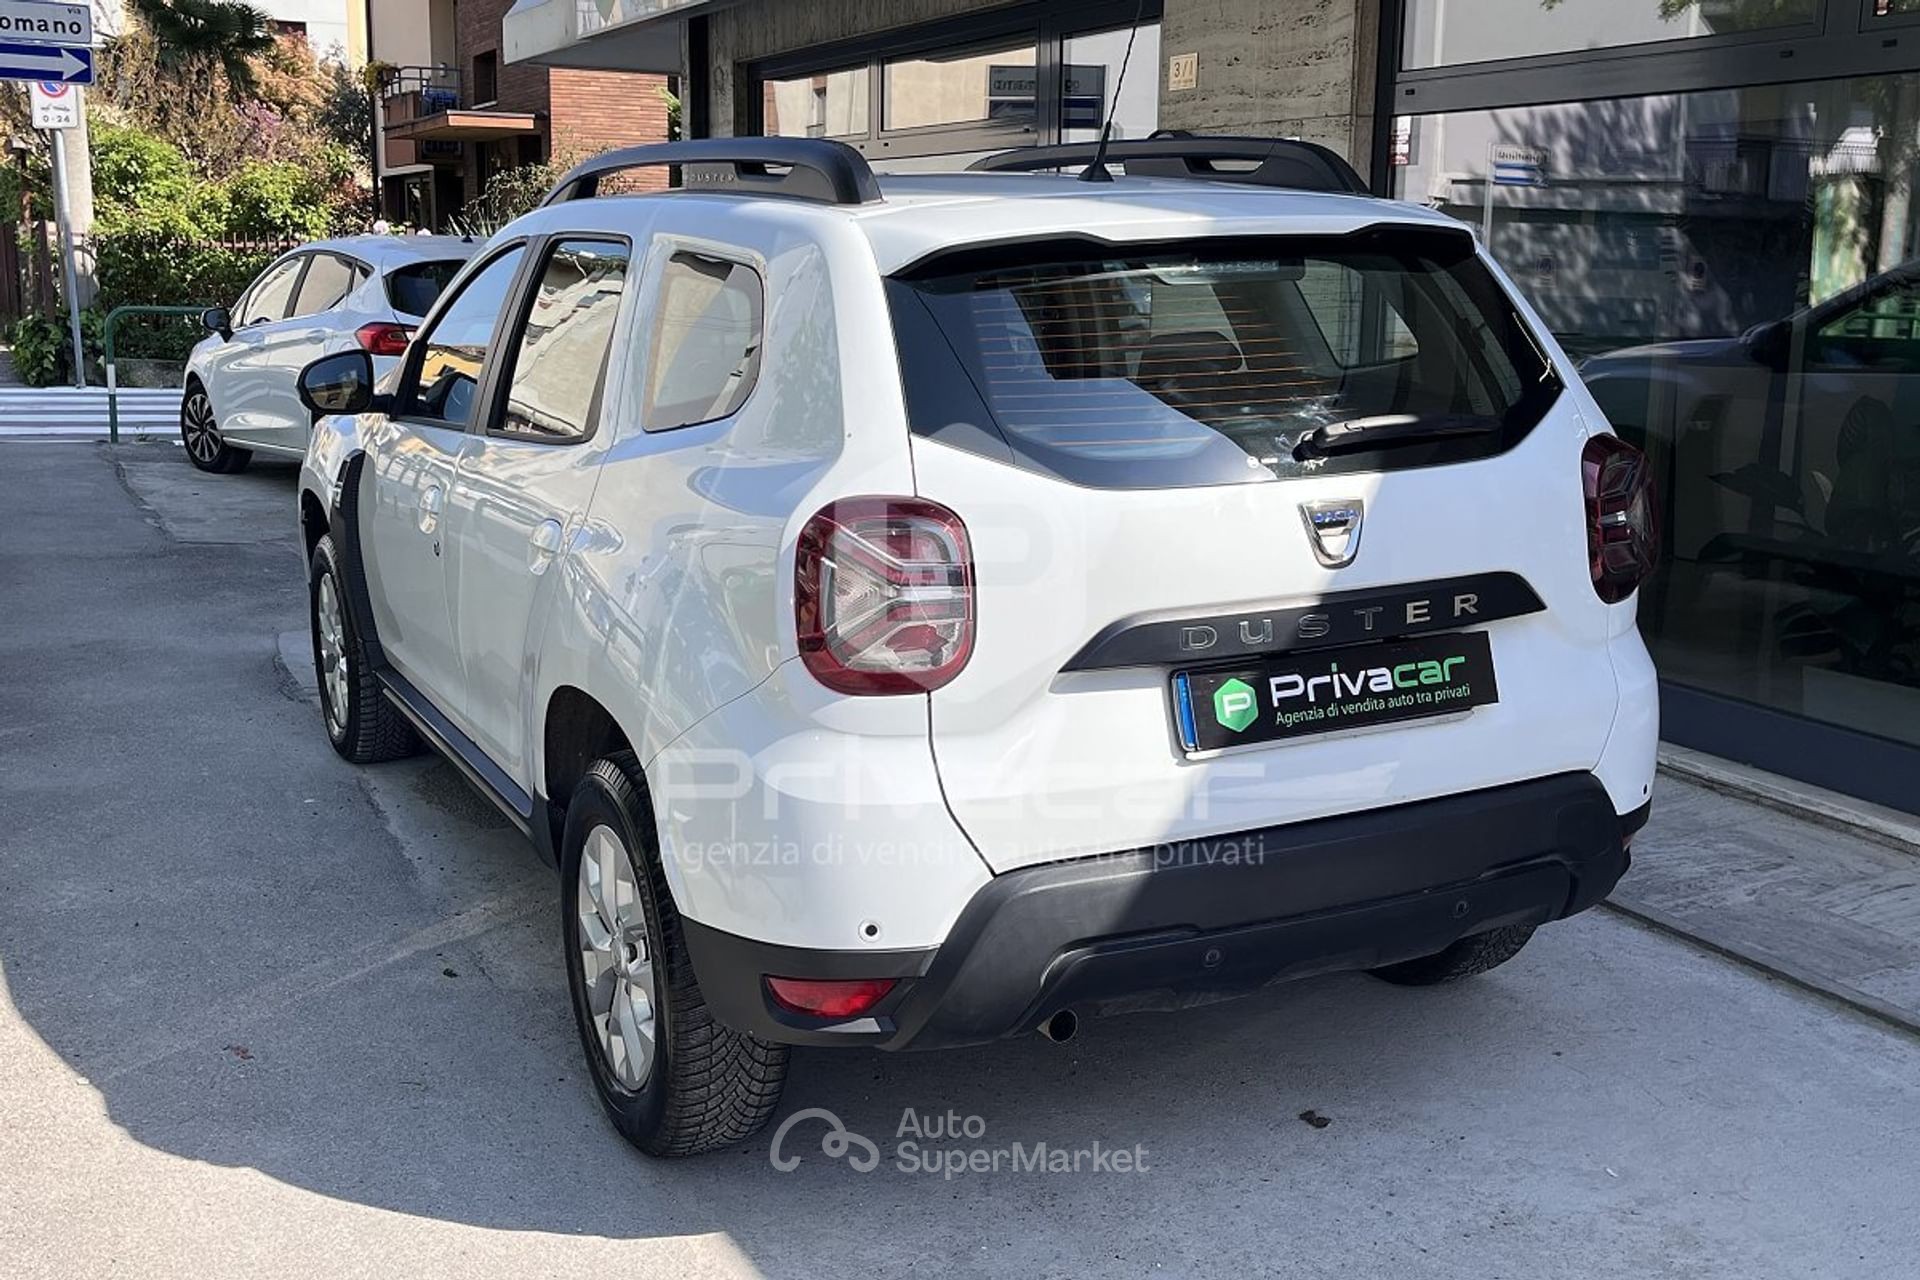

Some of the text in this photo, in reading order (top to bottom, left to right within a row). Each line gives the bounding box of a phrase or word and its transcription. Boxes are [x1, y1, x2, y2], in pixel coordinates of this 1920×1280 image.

[1181, 593, 1480, 651] DUSTER
[1269, 655, 1466, 708] Privacar
[1275, 682, 1471, 728] Agenzia di vendita auto tra privati
